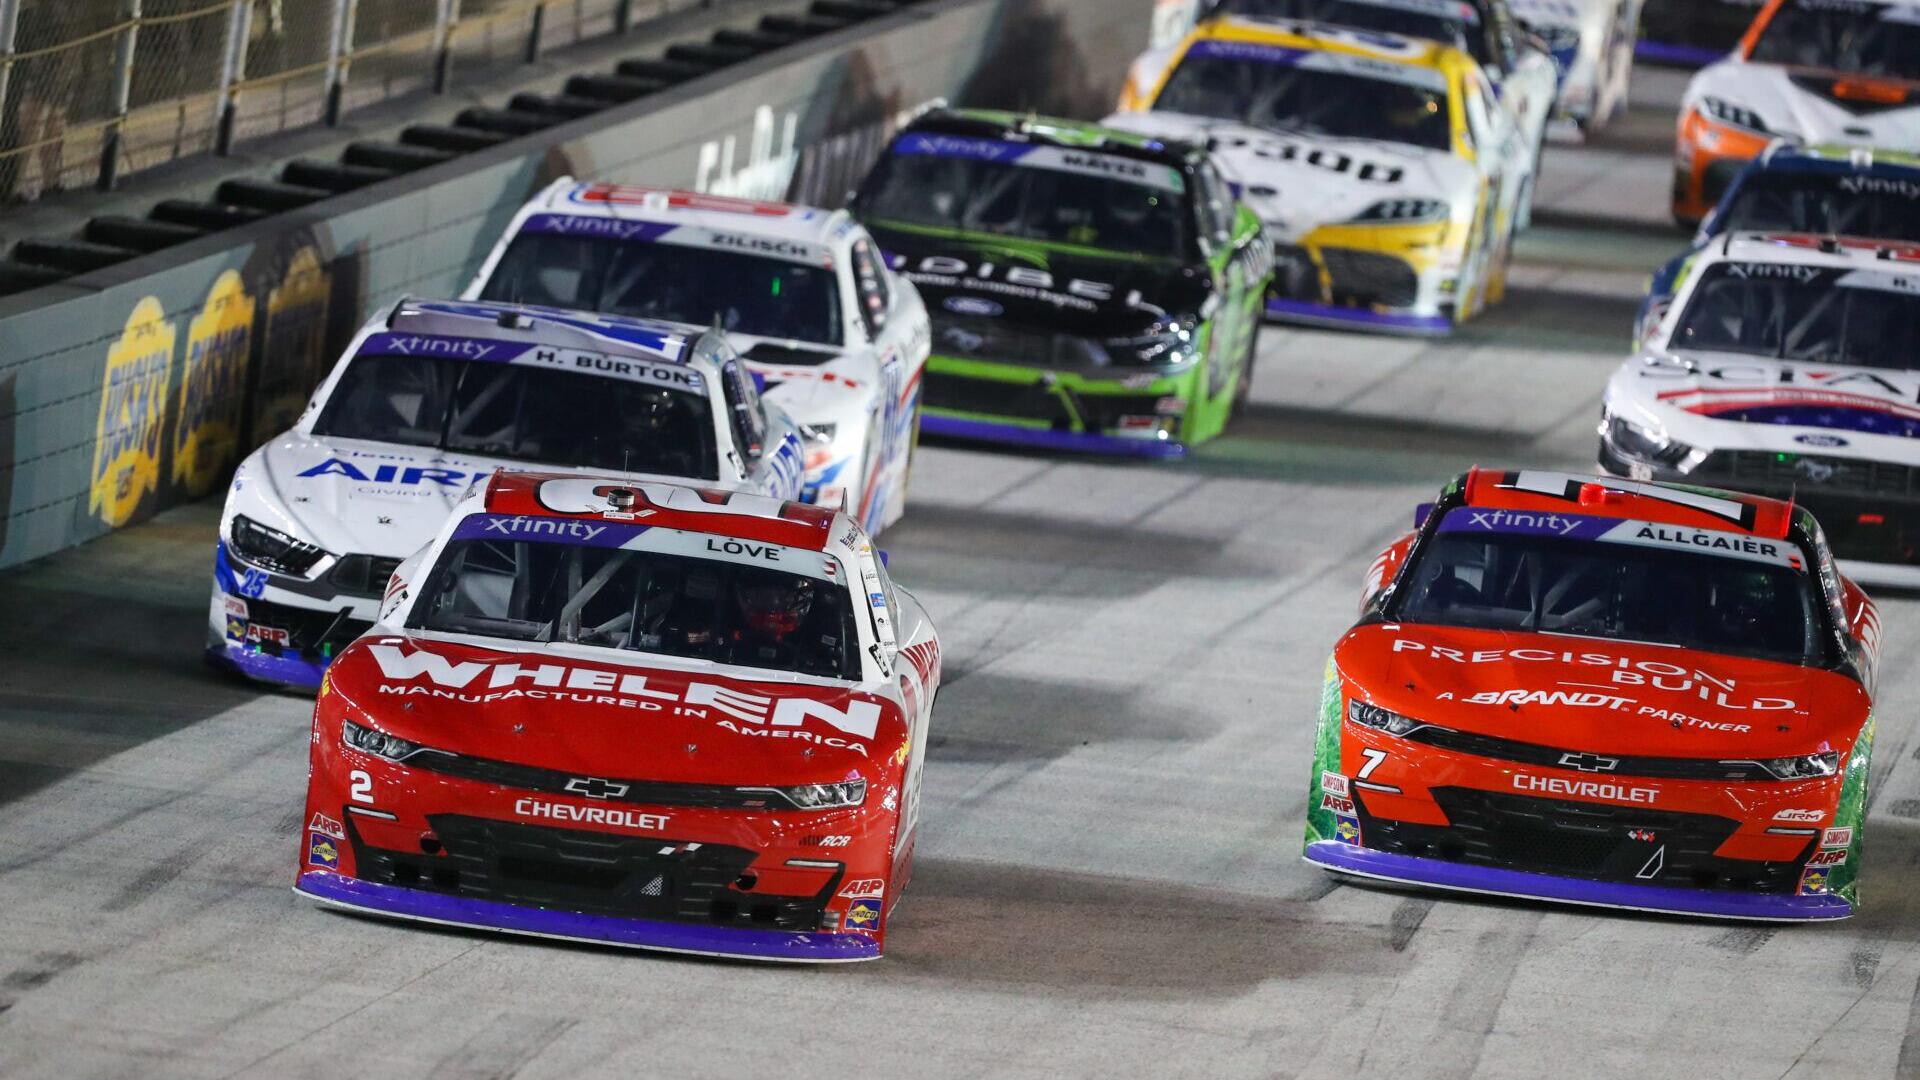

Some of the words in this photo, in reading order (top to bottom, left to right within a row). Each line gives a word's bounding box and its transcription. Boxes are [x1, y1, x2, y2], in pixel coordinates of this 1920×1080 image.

[545, 214, 645, 237] xfinity
[711, 232, 808, 256] ZILISCH
[387, 334, 497, 358] xfinity
[536, 350, 564, 365] H.
[576, 355, 692, 386] BURTON
[485, 516, 608, 541] xfinity
[1467, 510, 1584, 536] xfinity
[706, 538, 780, 561] LOVE
[1635, 526, 1779, 559] ALLGAIER
[240, 569, 270, 600] 25
[1391, 638, 1737, 693] PRECISION
[368, 645, 882, 740] WHELEN
[1611, 670, 1797, 712] BUILD
[378, 684, 663, 712] MANUFACTURED
[673, 706, 707, 719] IN
[716, 720, 869, 757] AMERICA
[1436, 691, 1454, 701] A
[1461, 689, 1638, 710] BRANDT
[1636, 706, 1753, 733] PARTNER
[1357, 747, 1389, 780] 7
[350, 769, 375, 804] 2
[1513, 774, 1661, 804] CHEVROLET
[515, 799, 671, 831] CHEVROLET
[1322, 794, 1355, 813] ARP
[1777, 812, 1820, 820] JRM
[311, 815, 342, 836] ARP
[818, 835, 852, 848] RCR
[1809, 850, 1848, 865] ARP
[843, 881, 883, 895] ARP
[848, 909, 879, 921] SUNOCO
